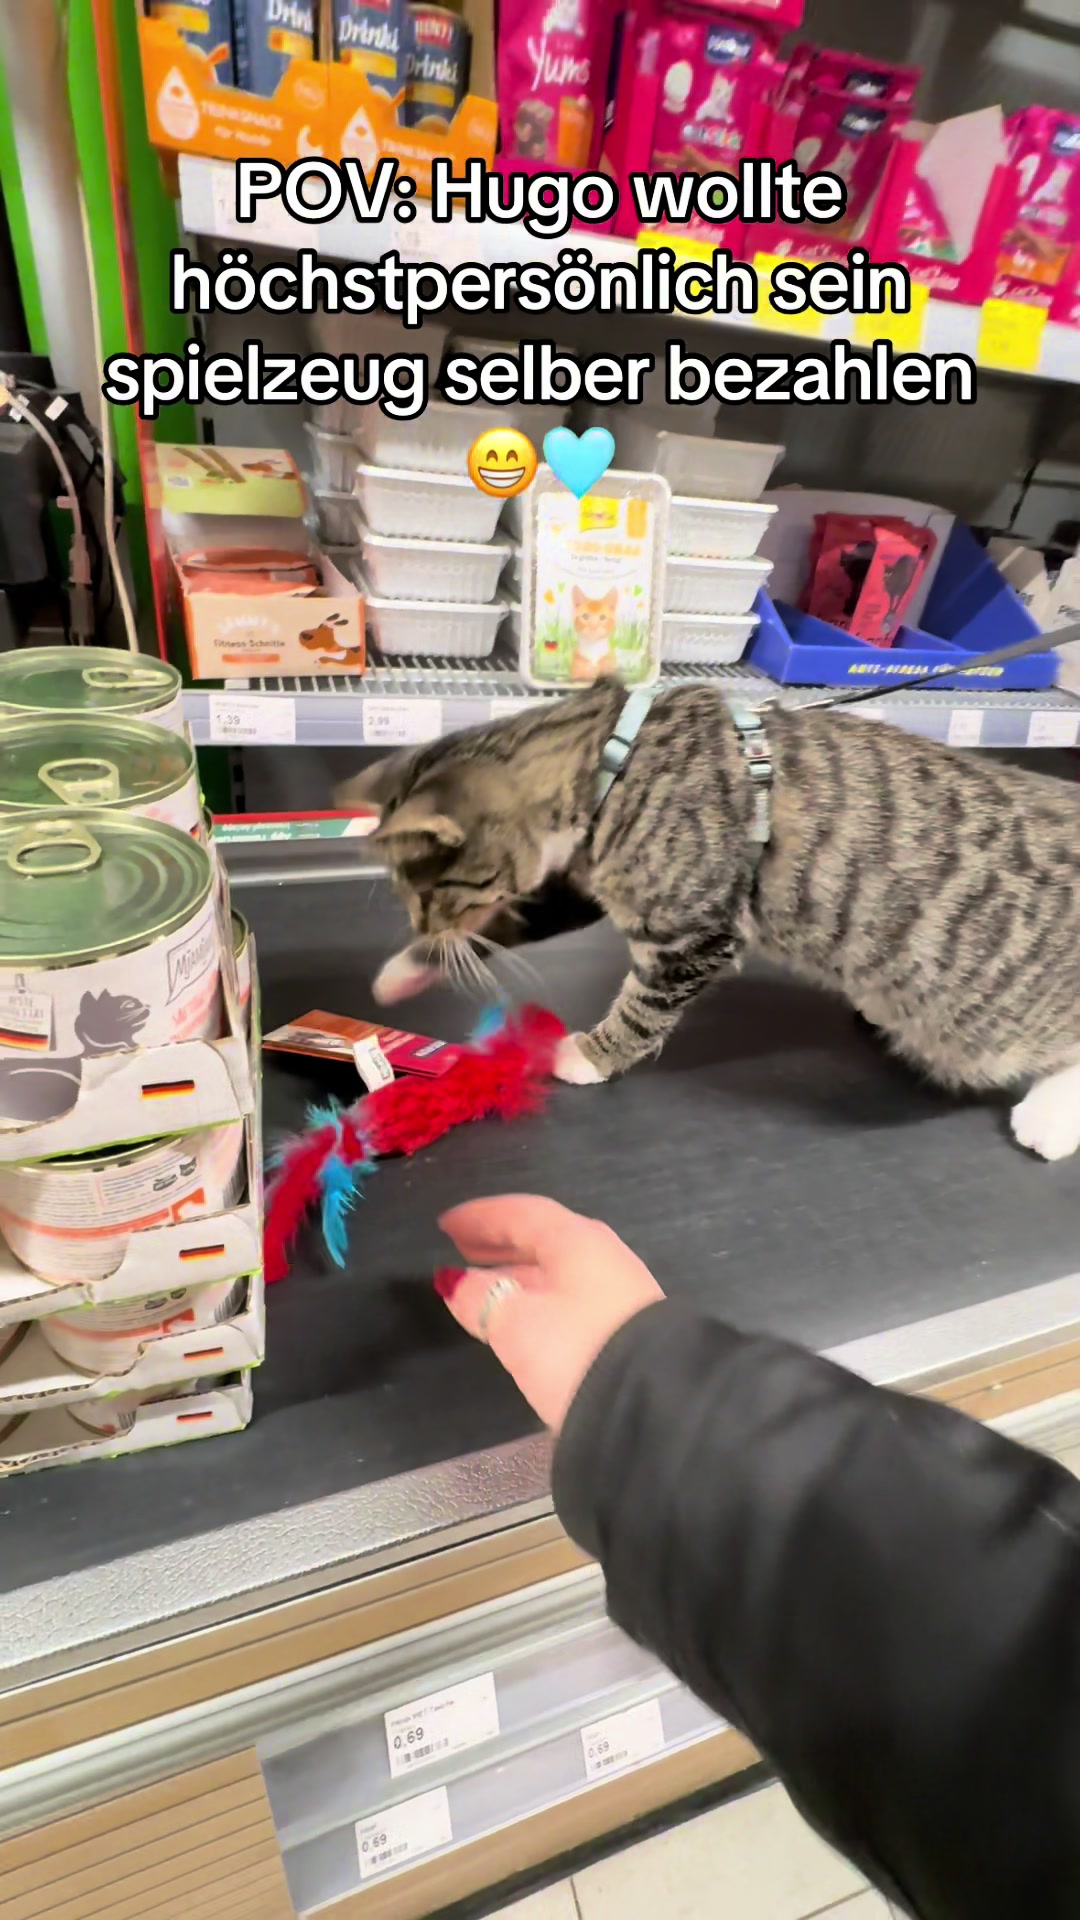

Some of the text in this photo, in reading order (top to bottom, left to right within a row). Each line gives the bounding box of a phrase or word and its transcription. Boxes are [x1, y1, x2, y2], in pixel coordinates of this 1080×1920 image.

[338, 14, 400, 53] Drinki
[405, 53, 459, 84] Drinki
[526, 34, 591, 92] Yums
[216, 714, 241, 726] 1.39
[368, 715, 391, 727] 2.99
[393, 1726, 425, 1750] 0.69
[587, 1740, 611, 1760] 0.69
[361, 1833, 388, 1854] 0.69
